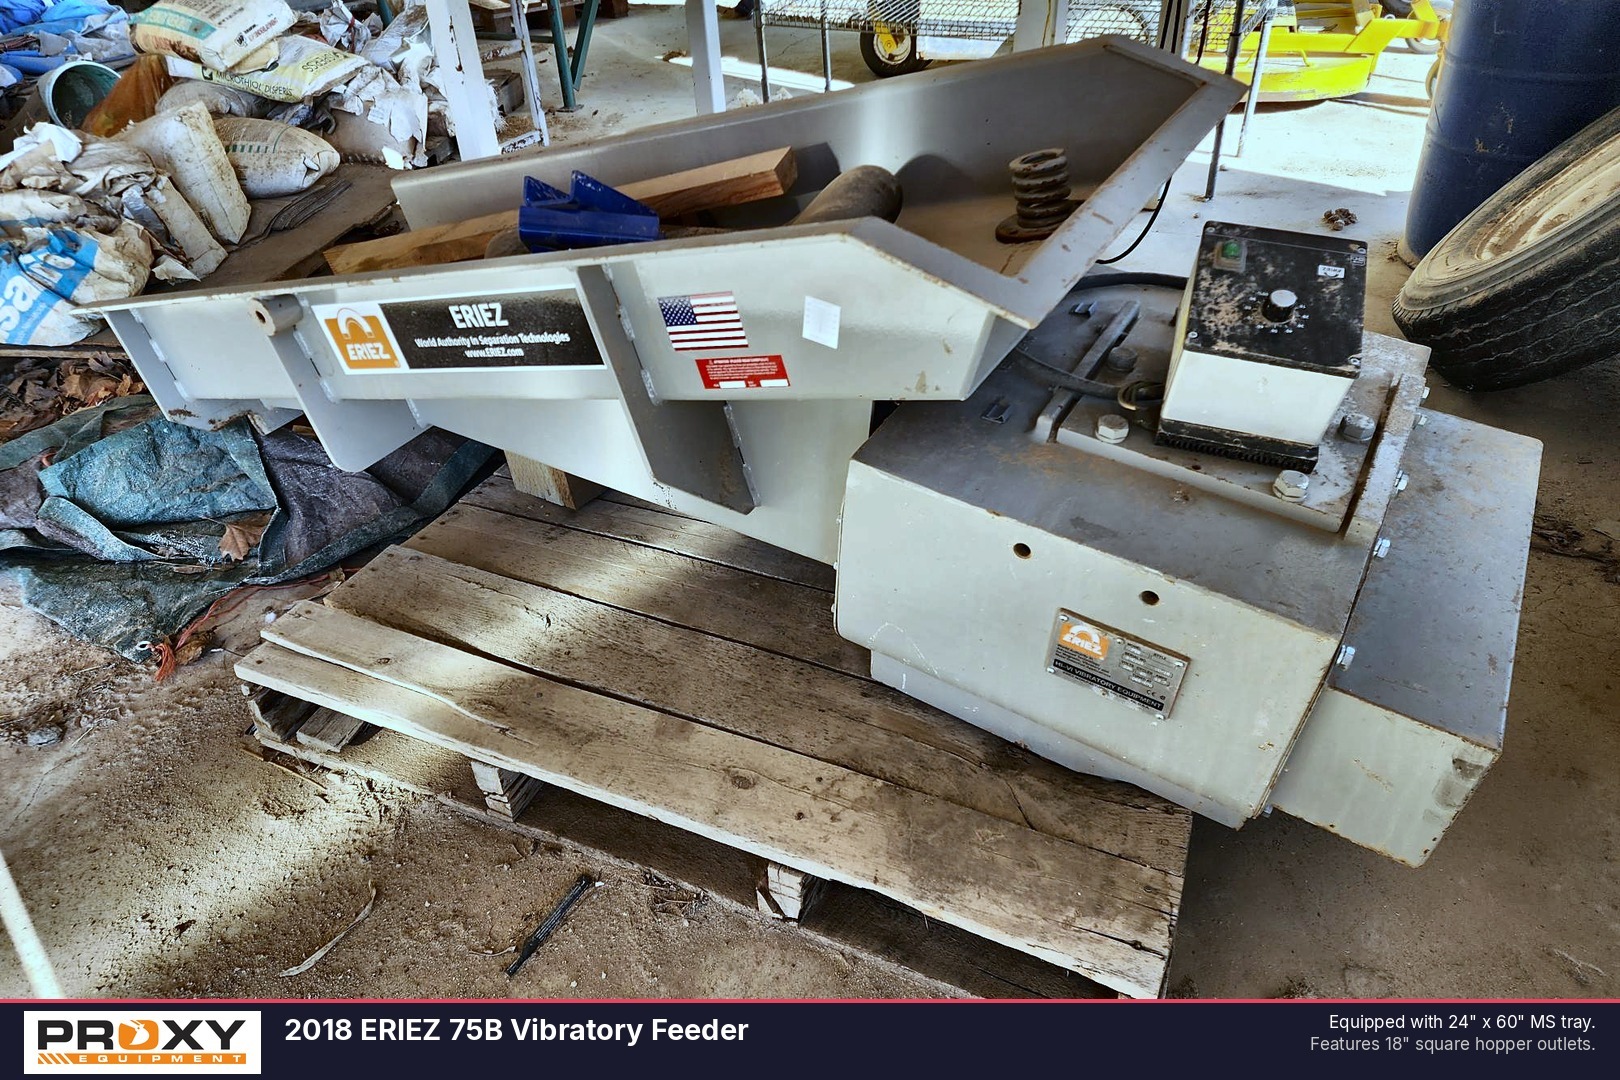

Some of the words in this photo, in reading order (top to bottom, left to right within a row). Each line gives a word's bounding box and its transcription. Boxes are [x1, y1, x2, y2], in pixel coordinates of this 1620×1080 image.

[448, 302, 509, 329] ERIEZ
[414, 337, 437, 348] World
[437, 335, 471, 348] Authority
[479, 333, 519, 347] Separation
[518, 331, 571, 344] Technologies
[346, 342, 391, 361] ERIEZ
[464, 347, 525, 358] www.ERIEZ.com
[1063, 633, 1102, 656] ERIEZ
[1074, 667, 1115, 690] VIBRATORY
[1117, 686, 1162, 709] EQUIPMENT
